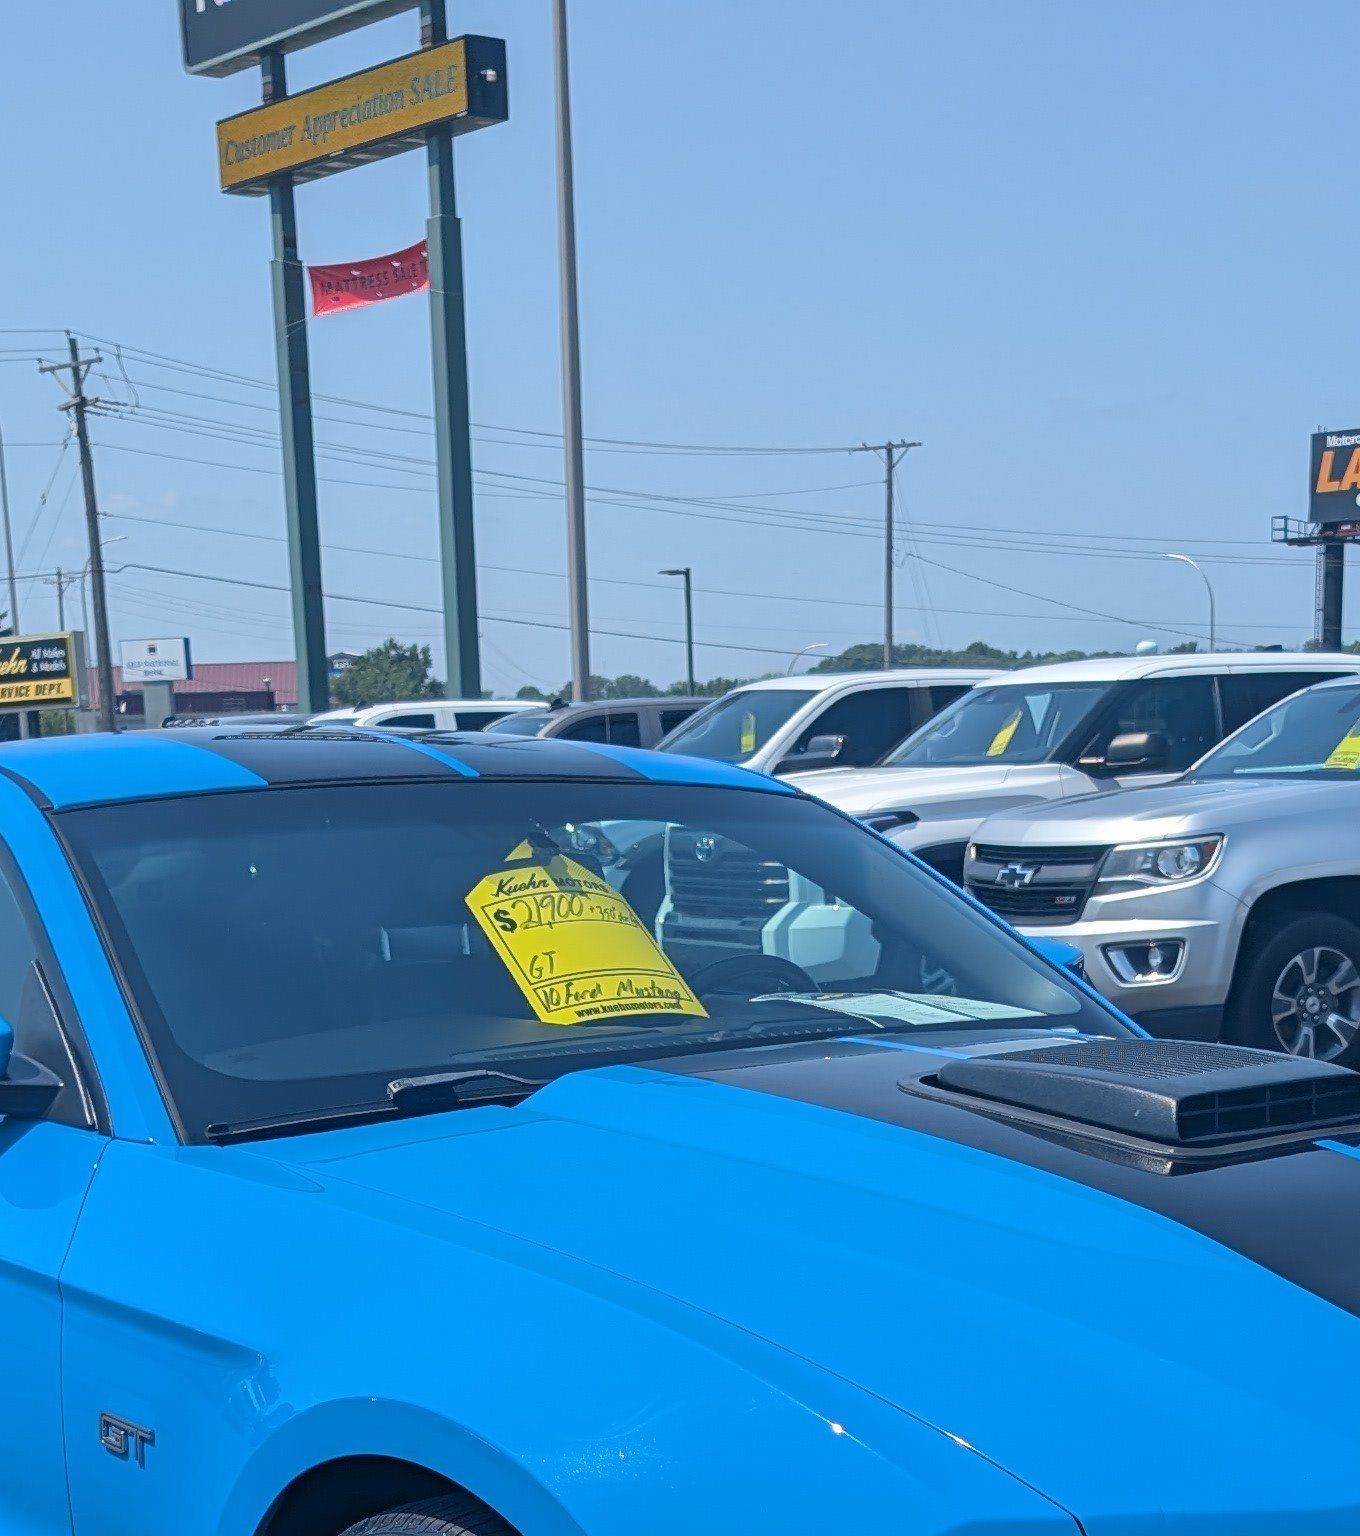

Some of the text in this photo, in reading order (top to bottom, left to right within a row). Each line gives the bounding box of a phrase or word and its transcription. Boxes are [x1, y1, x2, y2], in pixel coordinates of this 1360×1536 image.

[224, 63, 457, 166] Customer Appreciation SALE
[34, 682, 66, 696] DEPT.
[490, 873, 610, 898] Kuehn MOTORS
[529, 950, 556, 980] GT
[565, 981, 603, 1005] Ford
[575, 1001, 683, 1019] www.kuehnmotors.com
